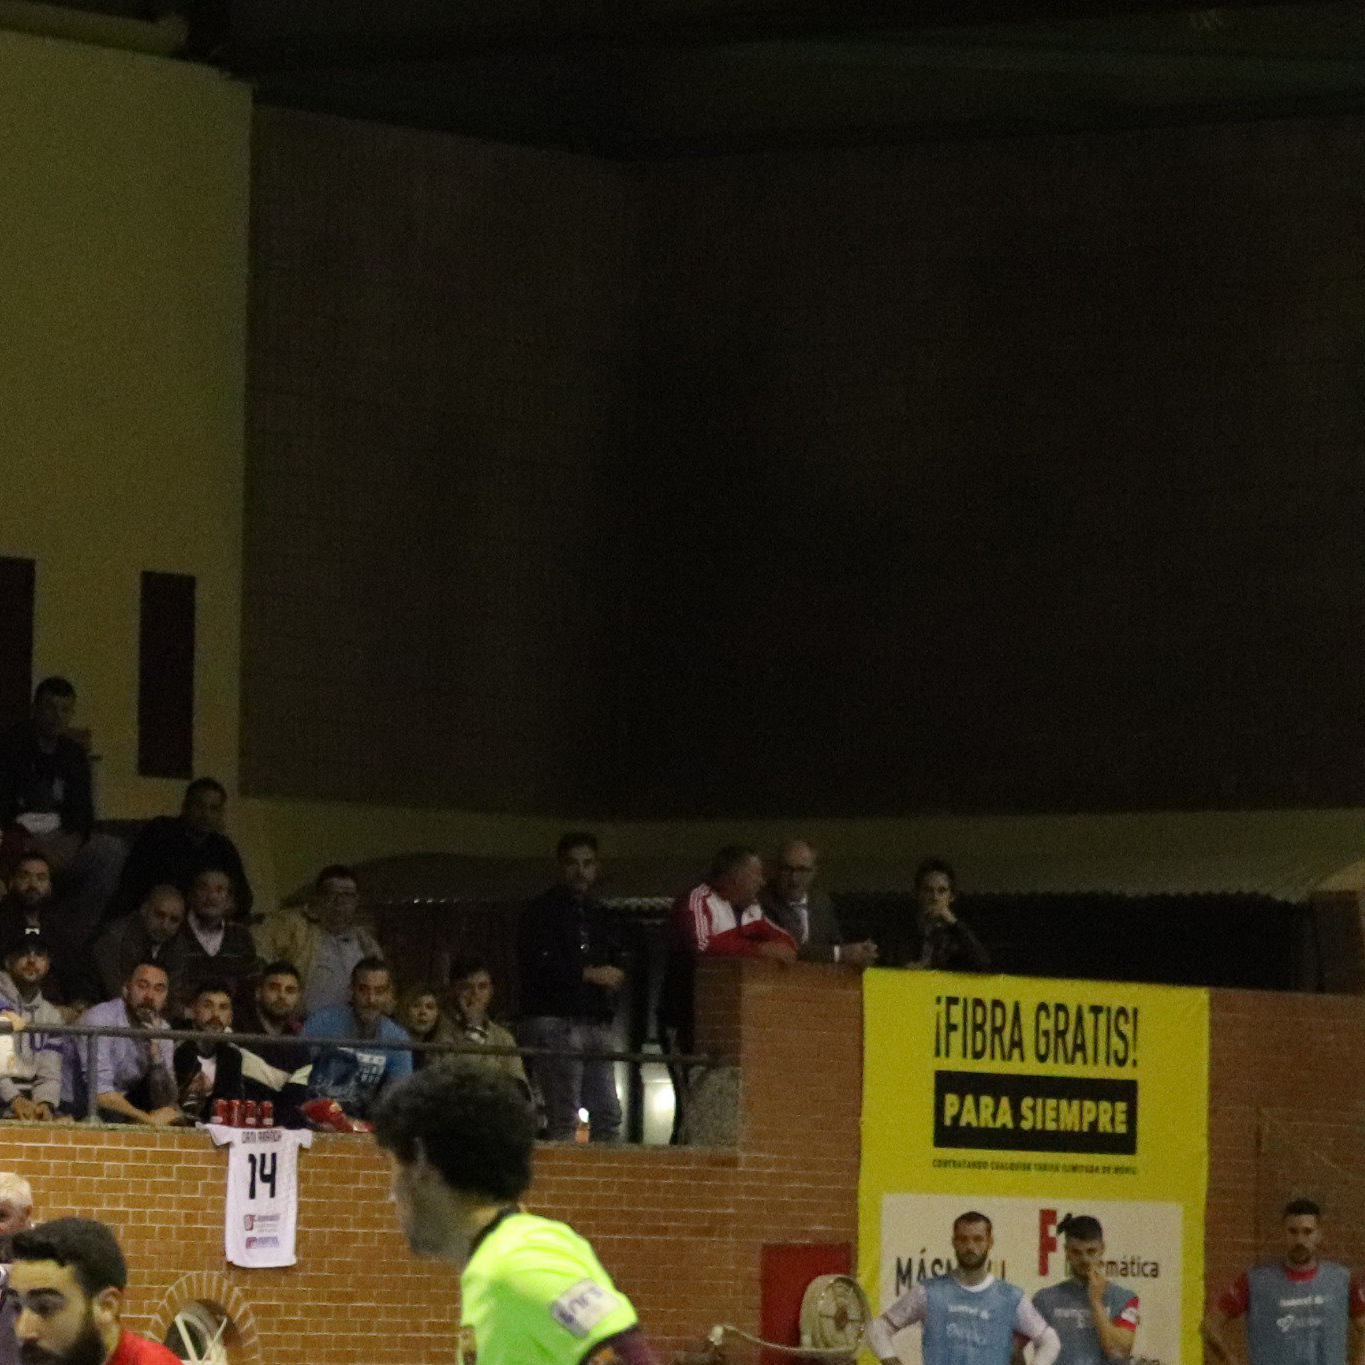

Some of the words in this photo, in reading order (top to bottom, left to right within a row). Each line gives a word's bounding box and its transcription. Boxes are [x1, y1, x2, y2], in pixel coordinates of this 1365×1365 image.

[934, 996, 1025, 1063] ¡FIBRA
[1034, 1001, 1139, 1068] GRATIS!
[943, 1093, 1014, 1130] PARA
[1020, 1097, 1128, 1134] SIEMPRE
[248, 1152, 277, 1199] 14
